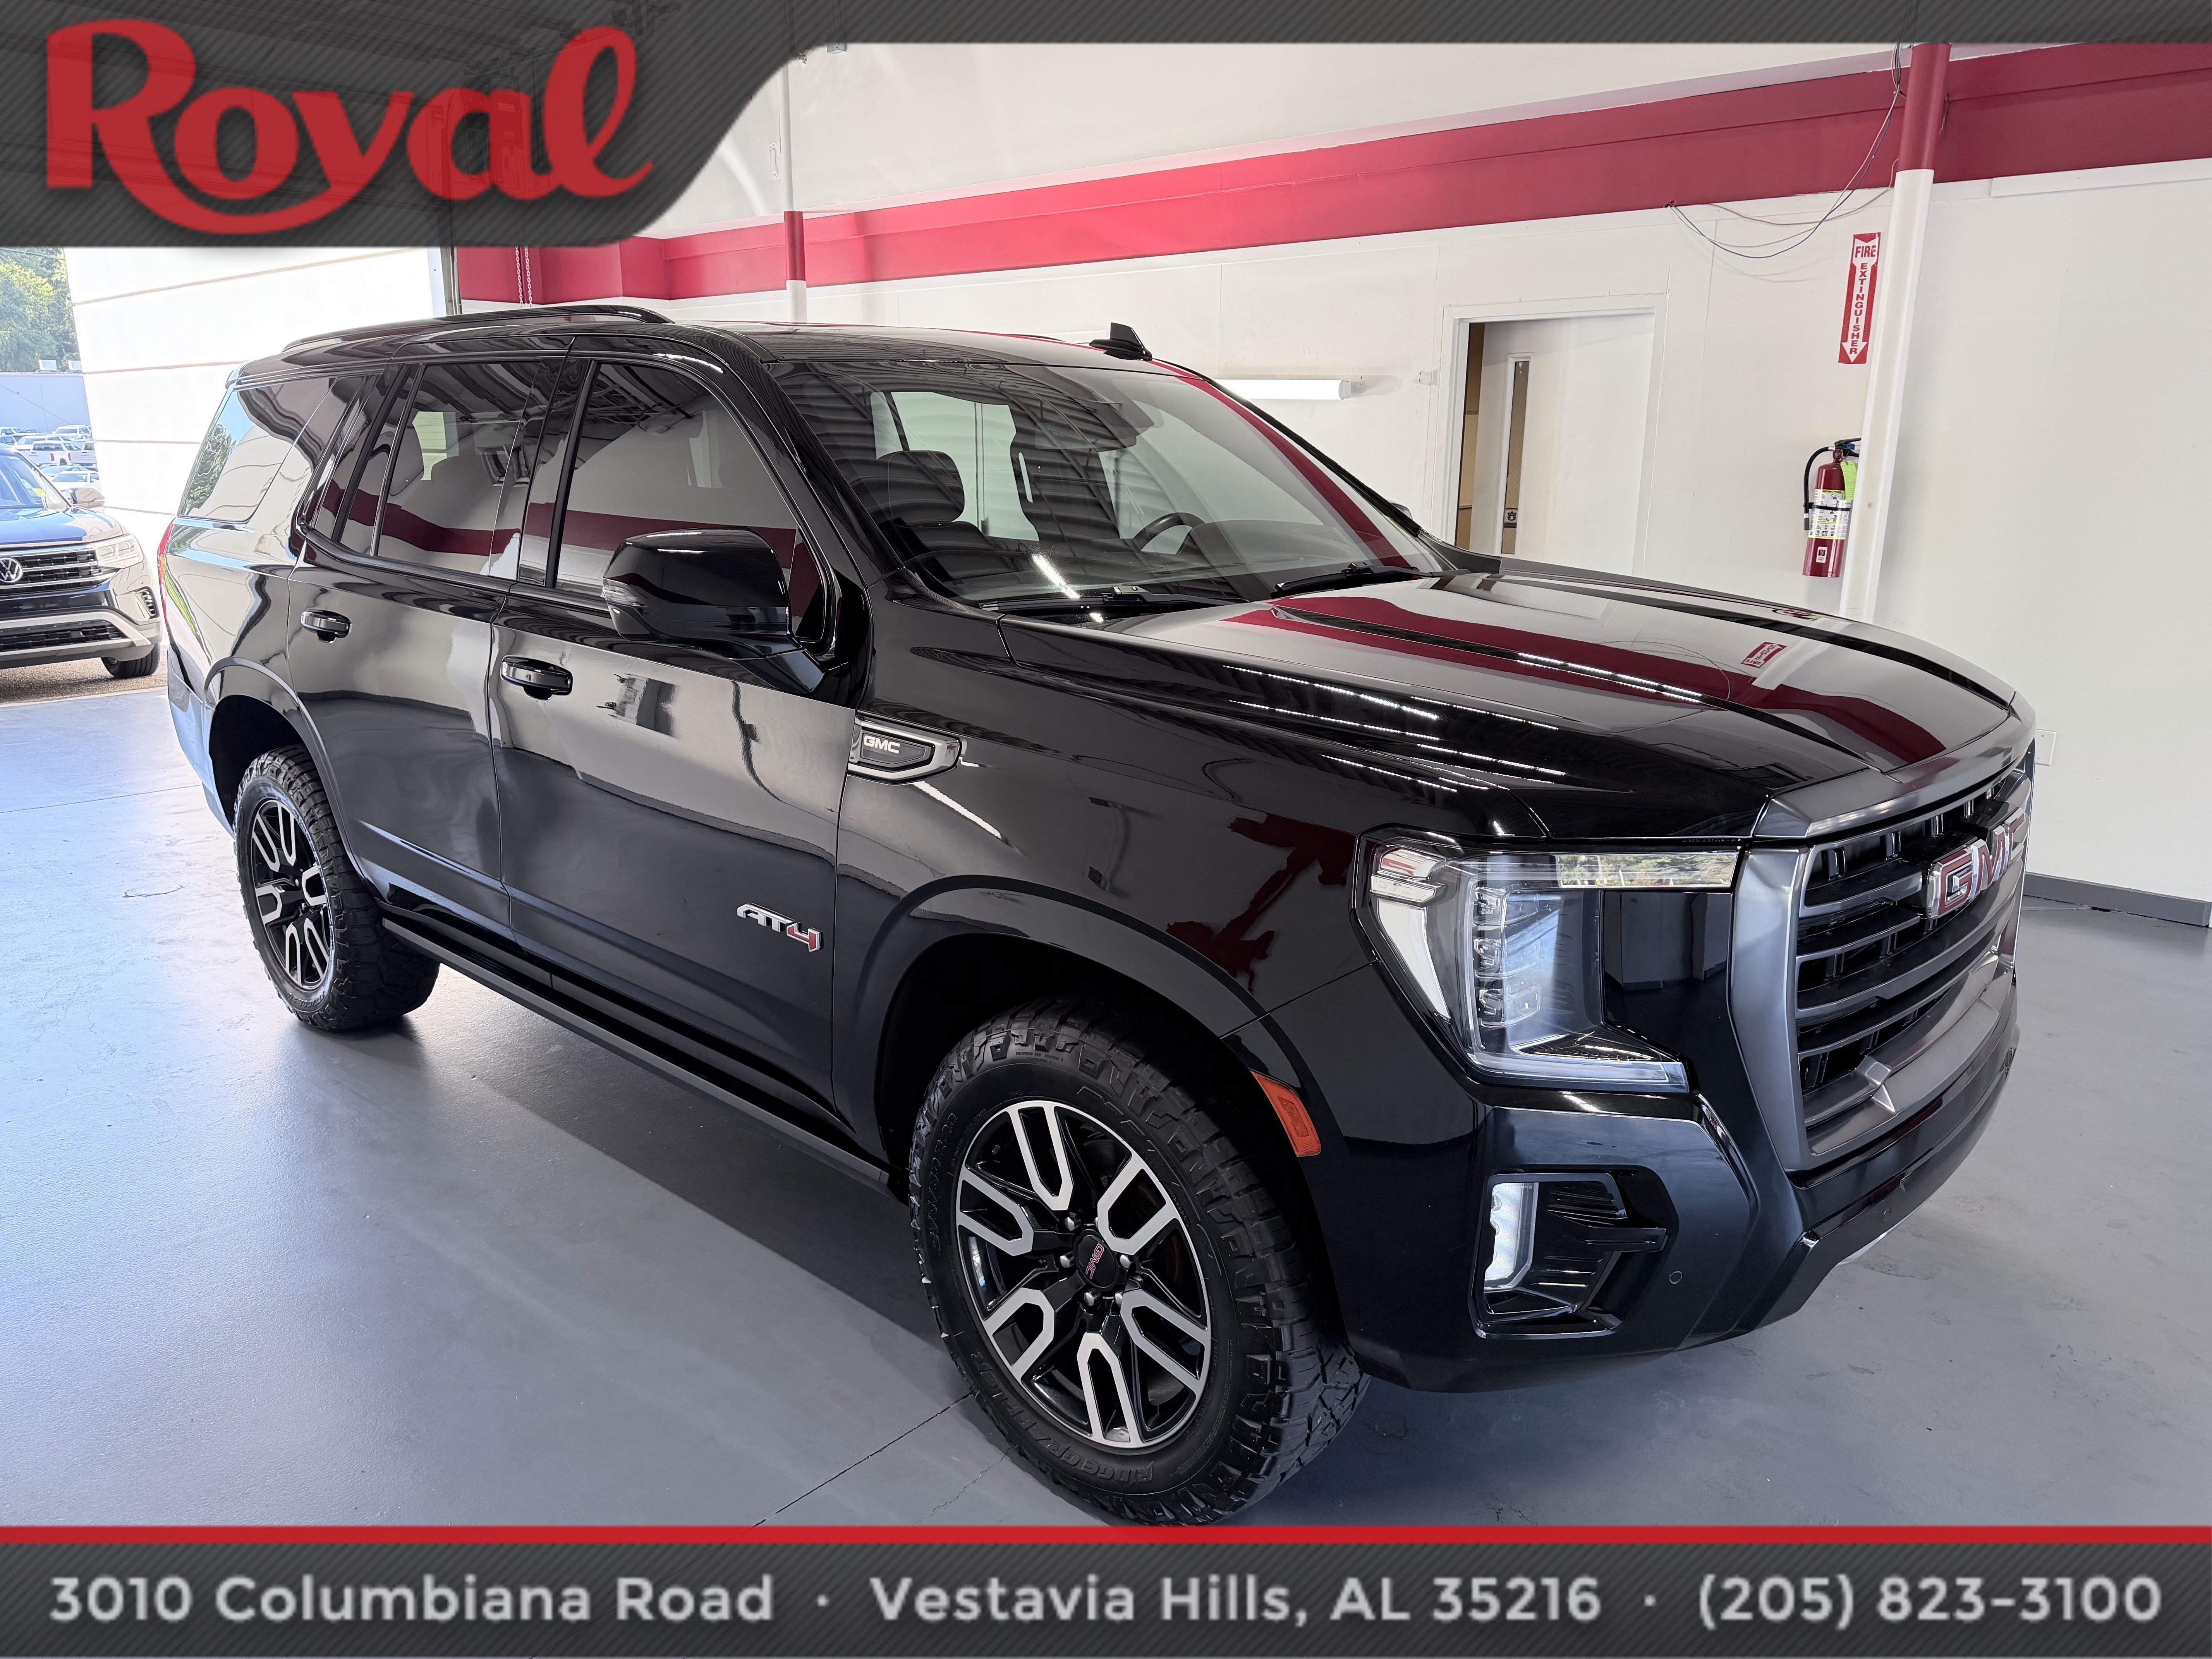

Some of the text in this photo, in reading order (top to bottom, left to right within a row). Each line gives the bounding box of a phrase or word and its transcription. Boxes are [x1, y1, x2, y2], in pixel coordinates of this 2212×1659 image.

[1855, 245, 1877, 258] FIRE
[1849, 262, 1868, 355] EXTINGUISHER
[863, 735, 900, 754] GMC
[1927, 807, 2027, 919] GMC
[737, 903, 822, 952] AT4
[1085, 1243, 1104, 1280] GMC
